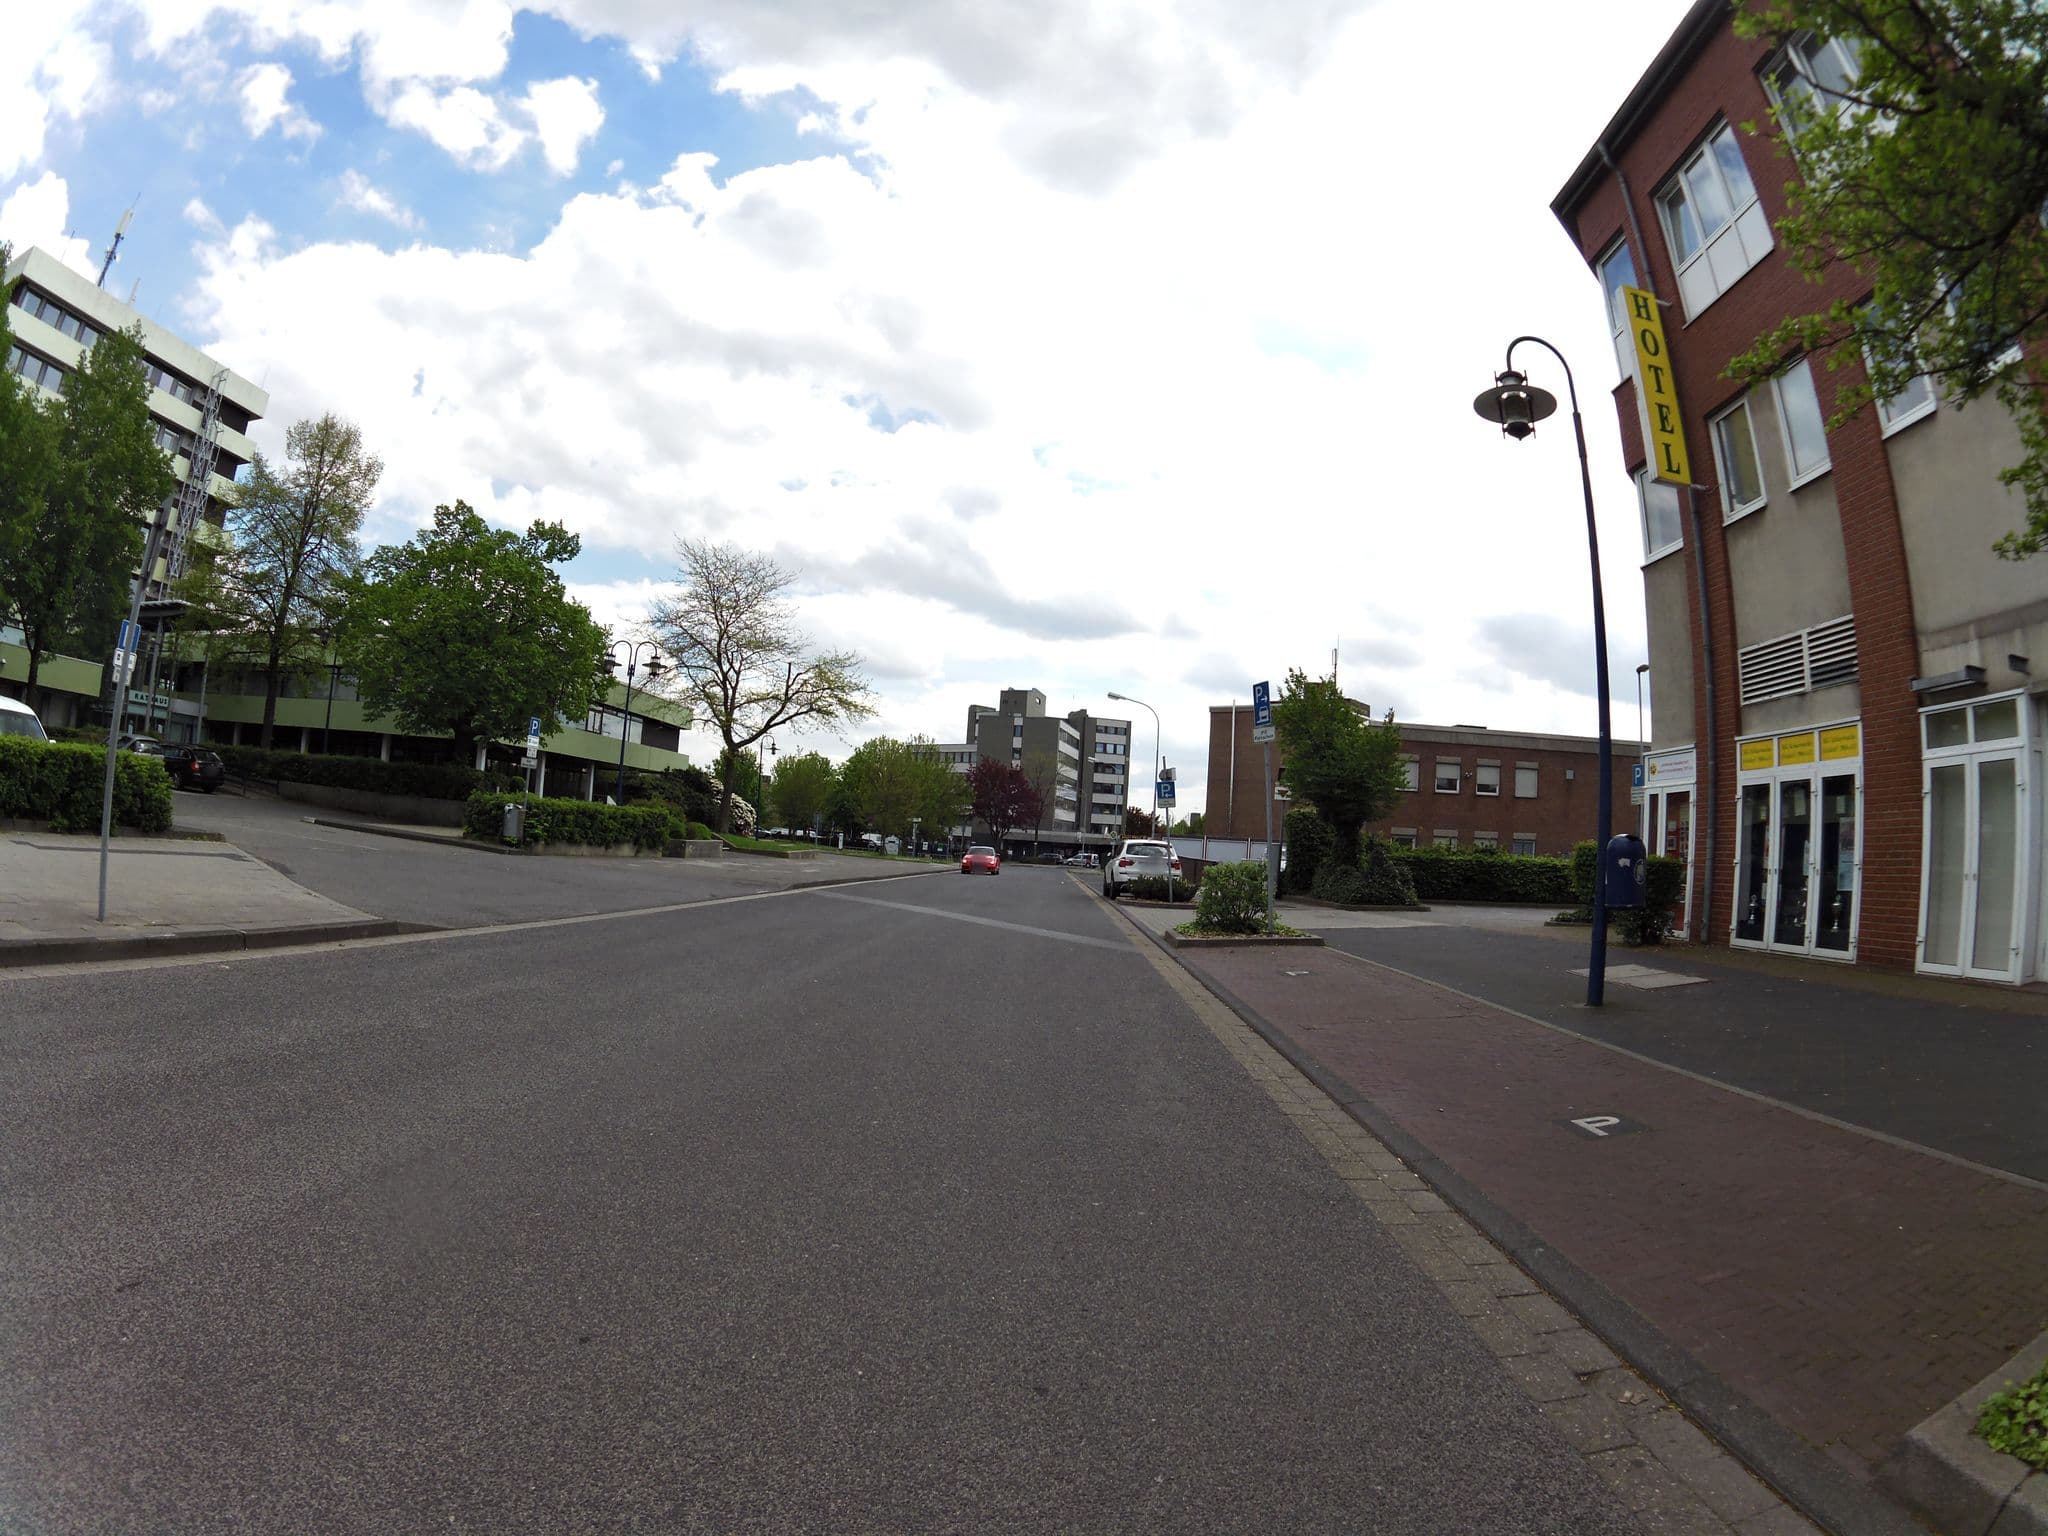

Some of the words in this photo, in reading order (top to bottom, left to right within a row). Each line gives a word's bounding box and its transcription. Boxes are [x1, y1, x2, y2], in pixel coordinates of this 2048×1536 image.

[1630, 292, 1681, 475] HOTEL
[134, 692, 168, 705] RATAUS
[1255, 685, 1263, 704] P
[531, 720, 539, 734] P
[1635, 767, 1642, 785] P
[1161, 783, 1171, 798] P
[1570, 1115, 1620, 1137] P
